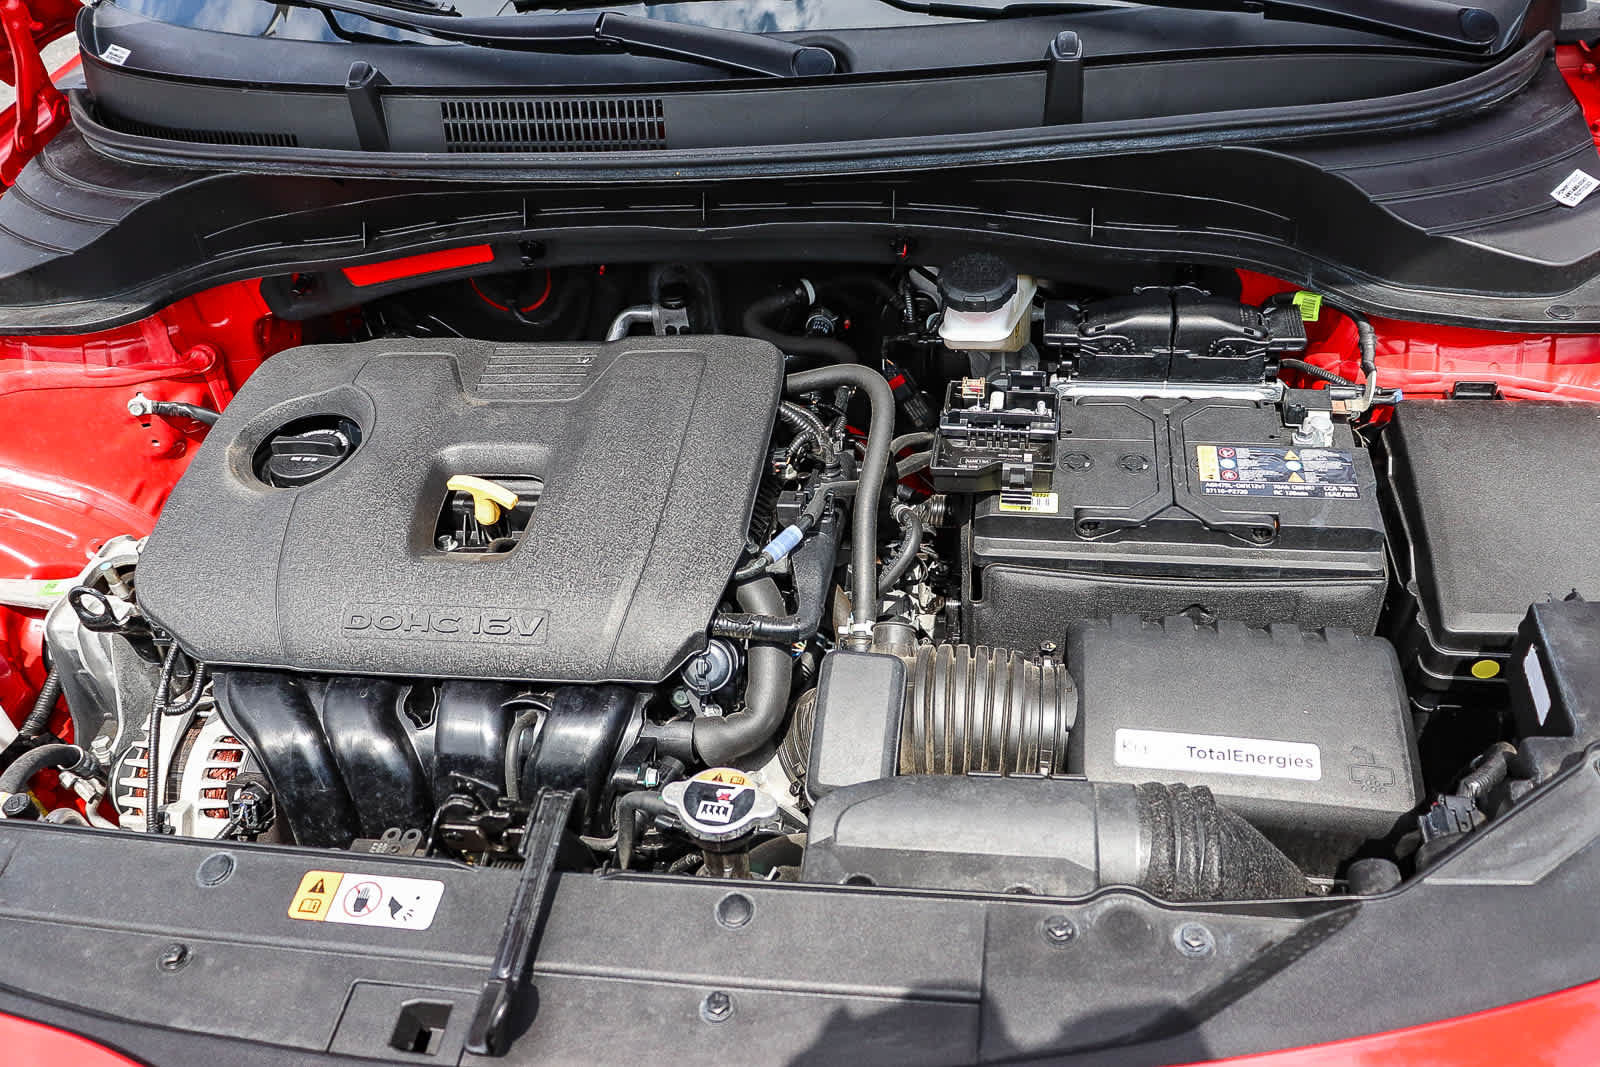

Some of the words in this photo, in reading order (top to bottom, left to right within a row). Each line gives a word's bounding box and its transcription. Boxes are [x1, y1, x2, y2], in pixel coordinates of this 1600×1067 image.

[343, 611, 461, 634] DOHC
[472, 613, 545, 637] 16V
[1186, 746, 1314, 769] TotalEnergies
